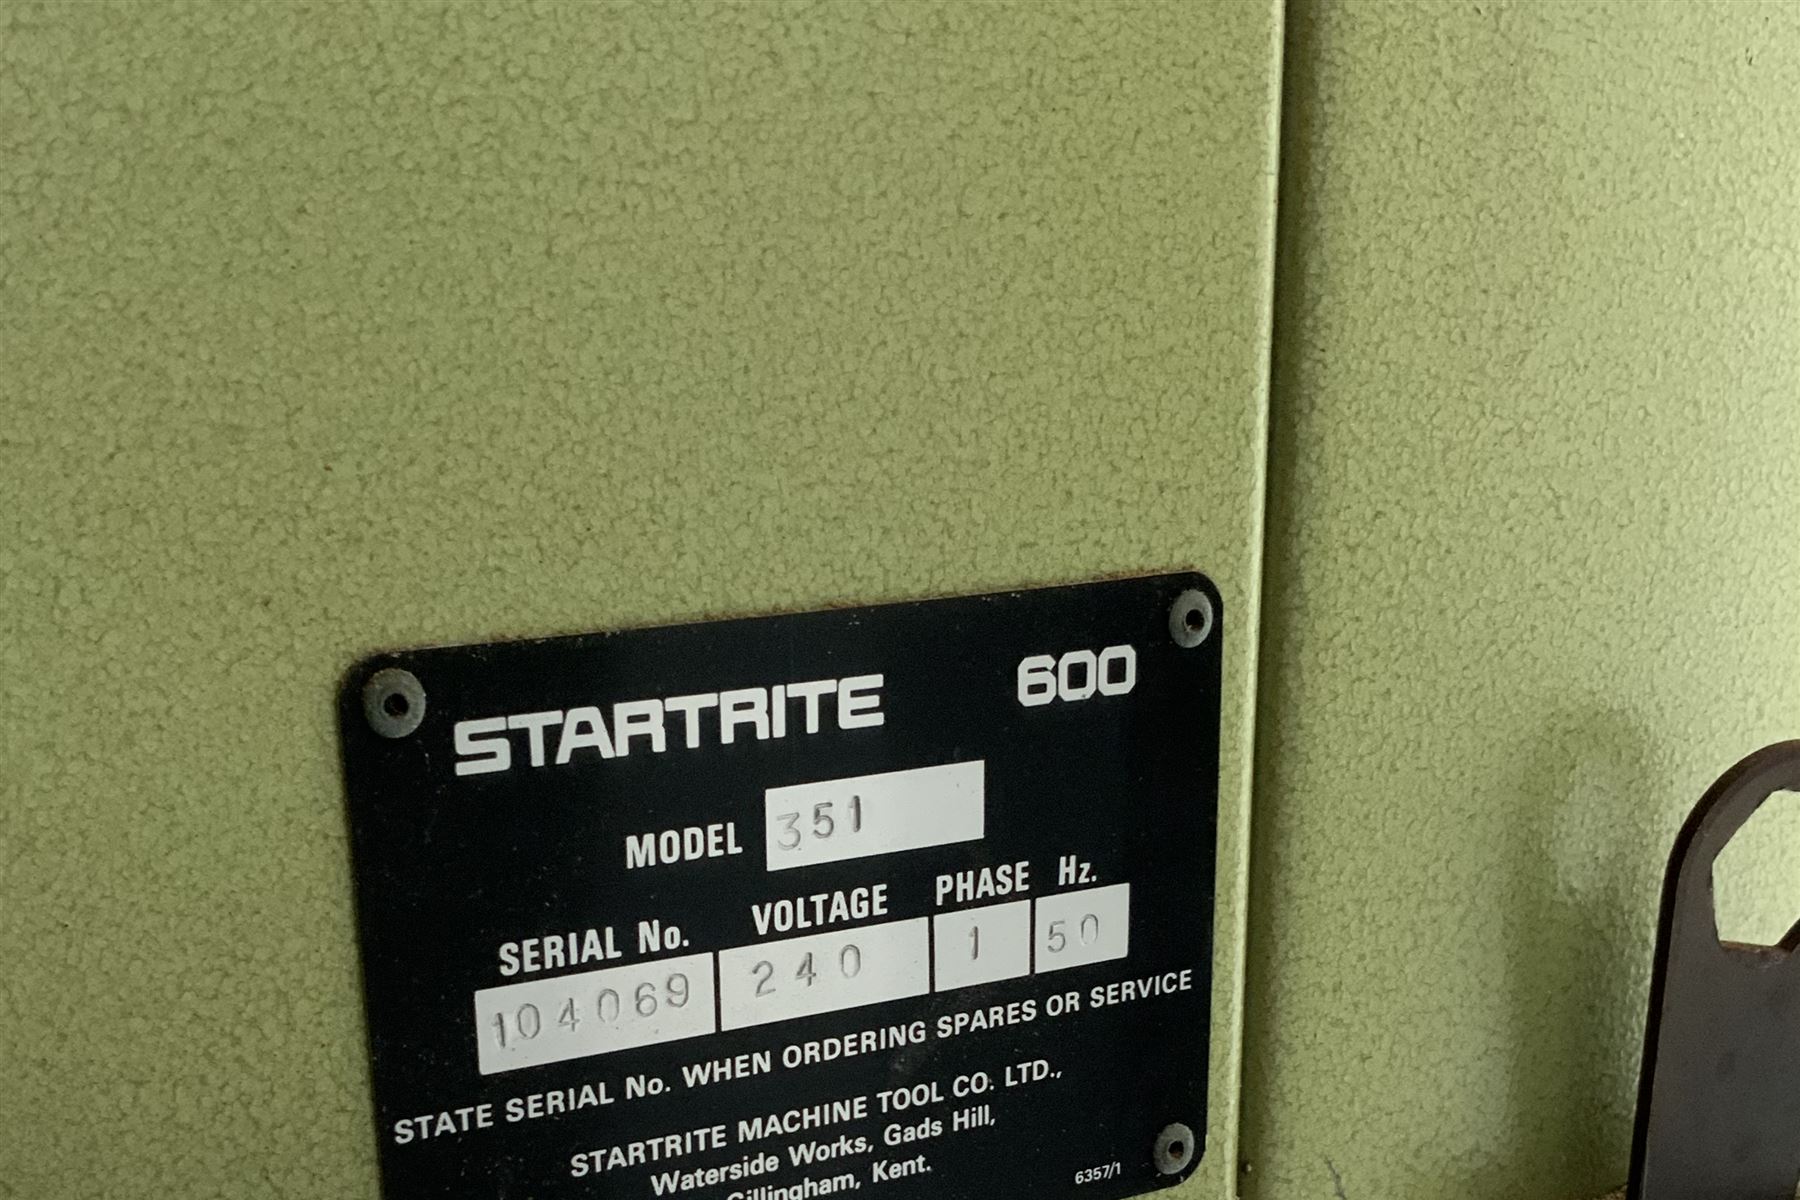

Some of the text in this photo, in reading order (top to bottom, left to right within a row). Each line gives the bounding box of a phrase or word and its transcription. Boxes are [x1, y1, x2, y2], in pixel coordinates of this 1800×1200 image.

[1017, 644, 1137, 707] 600
[454, 674, 885, 776] STARTRITE
[625, 795, 862, 869] MODEL 351
[935, 861, 1030, 906] PHASE
[1058, 855, 1097, 885] Hz.
[752, 884, 888, 935] VOLTAGE
[1046, 913, 1100, 954] 50
[499, 920, 689, 977] SERIAL No.
[968, 925, 979, 961] 1
[752, 944, 862, 998] 240
[491, 973, 690, 1049] 104069
[394, 969, 1192, 1144] STATE SERIAL No. WHEN ORDERING SPARES OR SERVICE
[570, 1059, 1062, 1178] STARTRITE MACHINE TOOL CO. LTD.,
[650, 1104, 996, 1196] Waterside Works, Gads Hill,
[872, 1155, 931, 1184] Kent.
[1074, 1161, 1122, 1185] 6357/1
